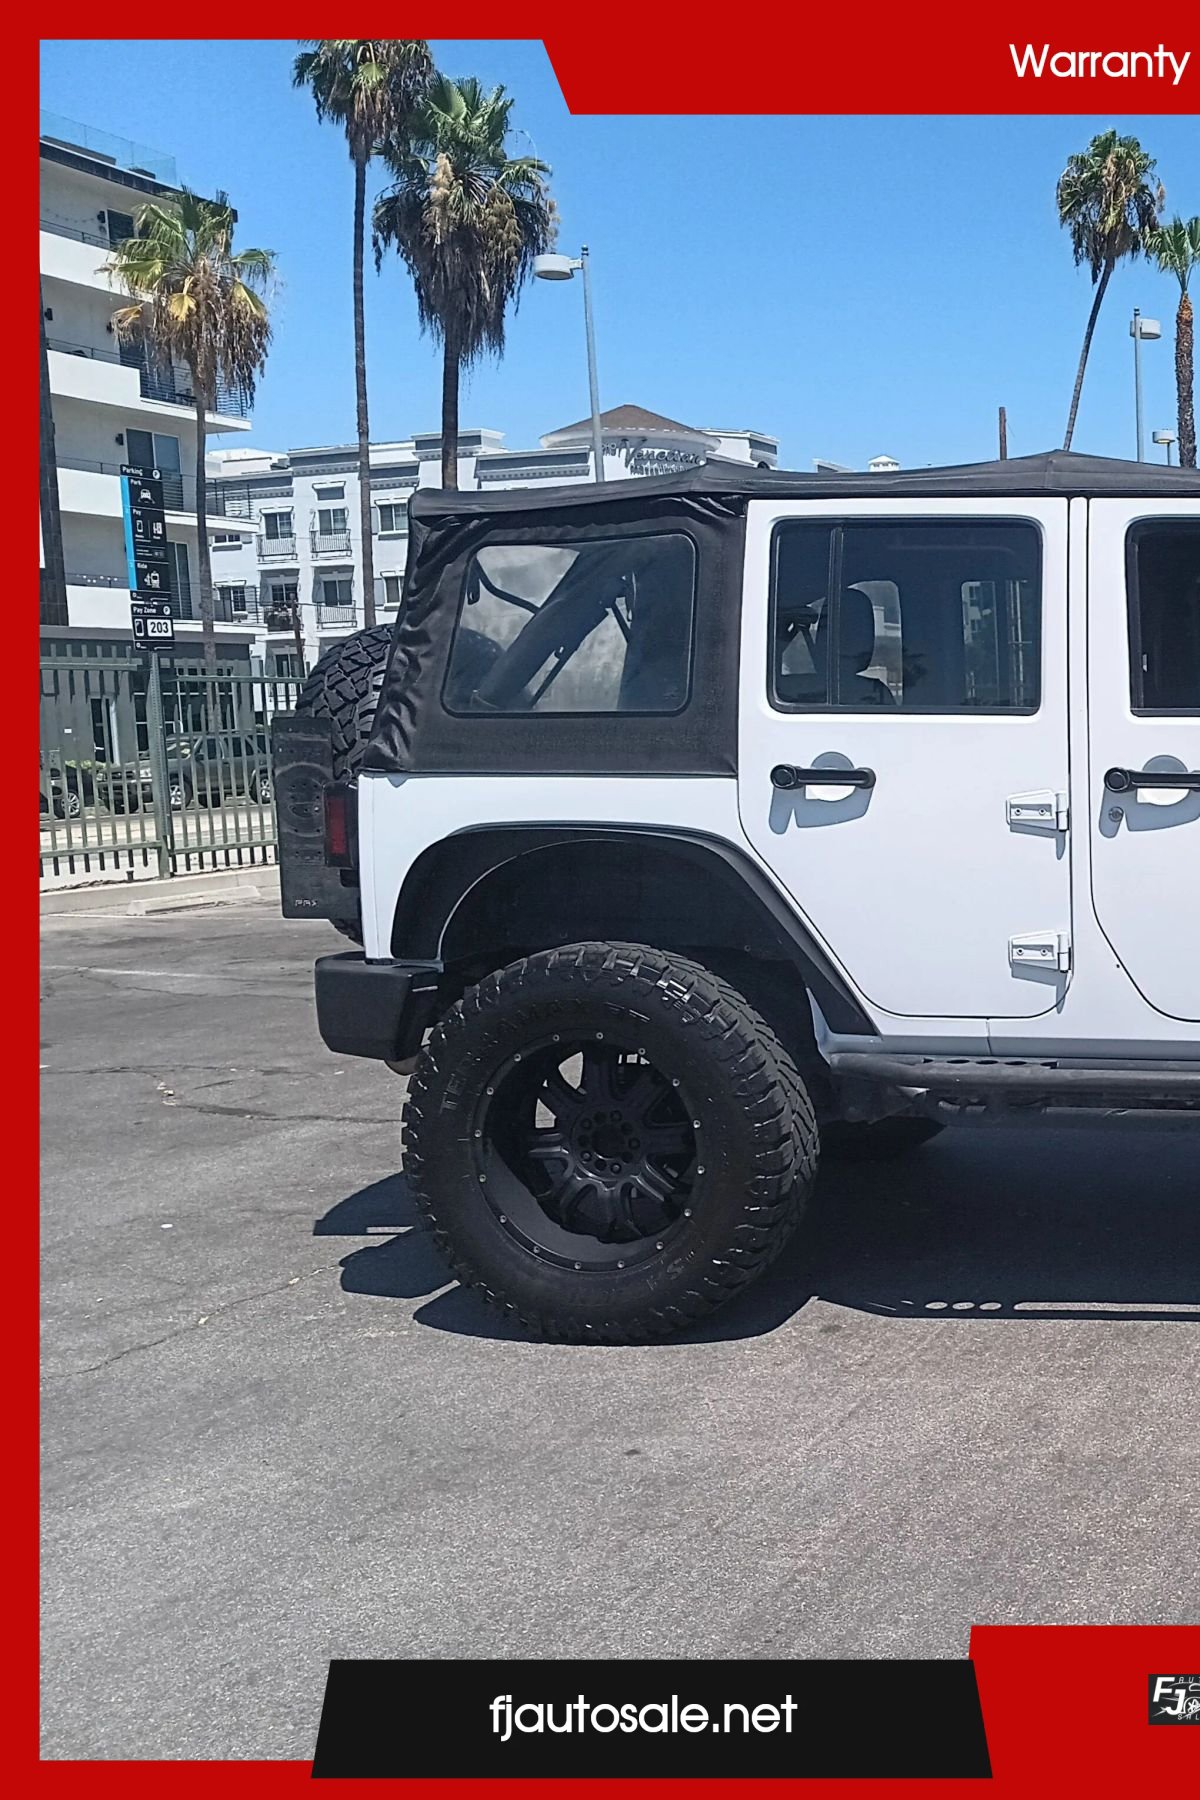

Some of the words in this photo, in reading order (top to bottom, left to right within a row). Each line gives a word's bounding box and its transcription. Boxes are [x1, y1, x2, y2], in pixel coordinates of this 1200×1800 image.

[122, 466, 143, 476] Parking
[133, 606, 143, 614] Pay
[149, 621, 169, 634] 203
